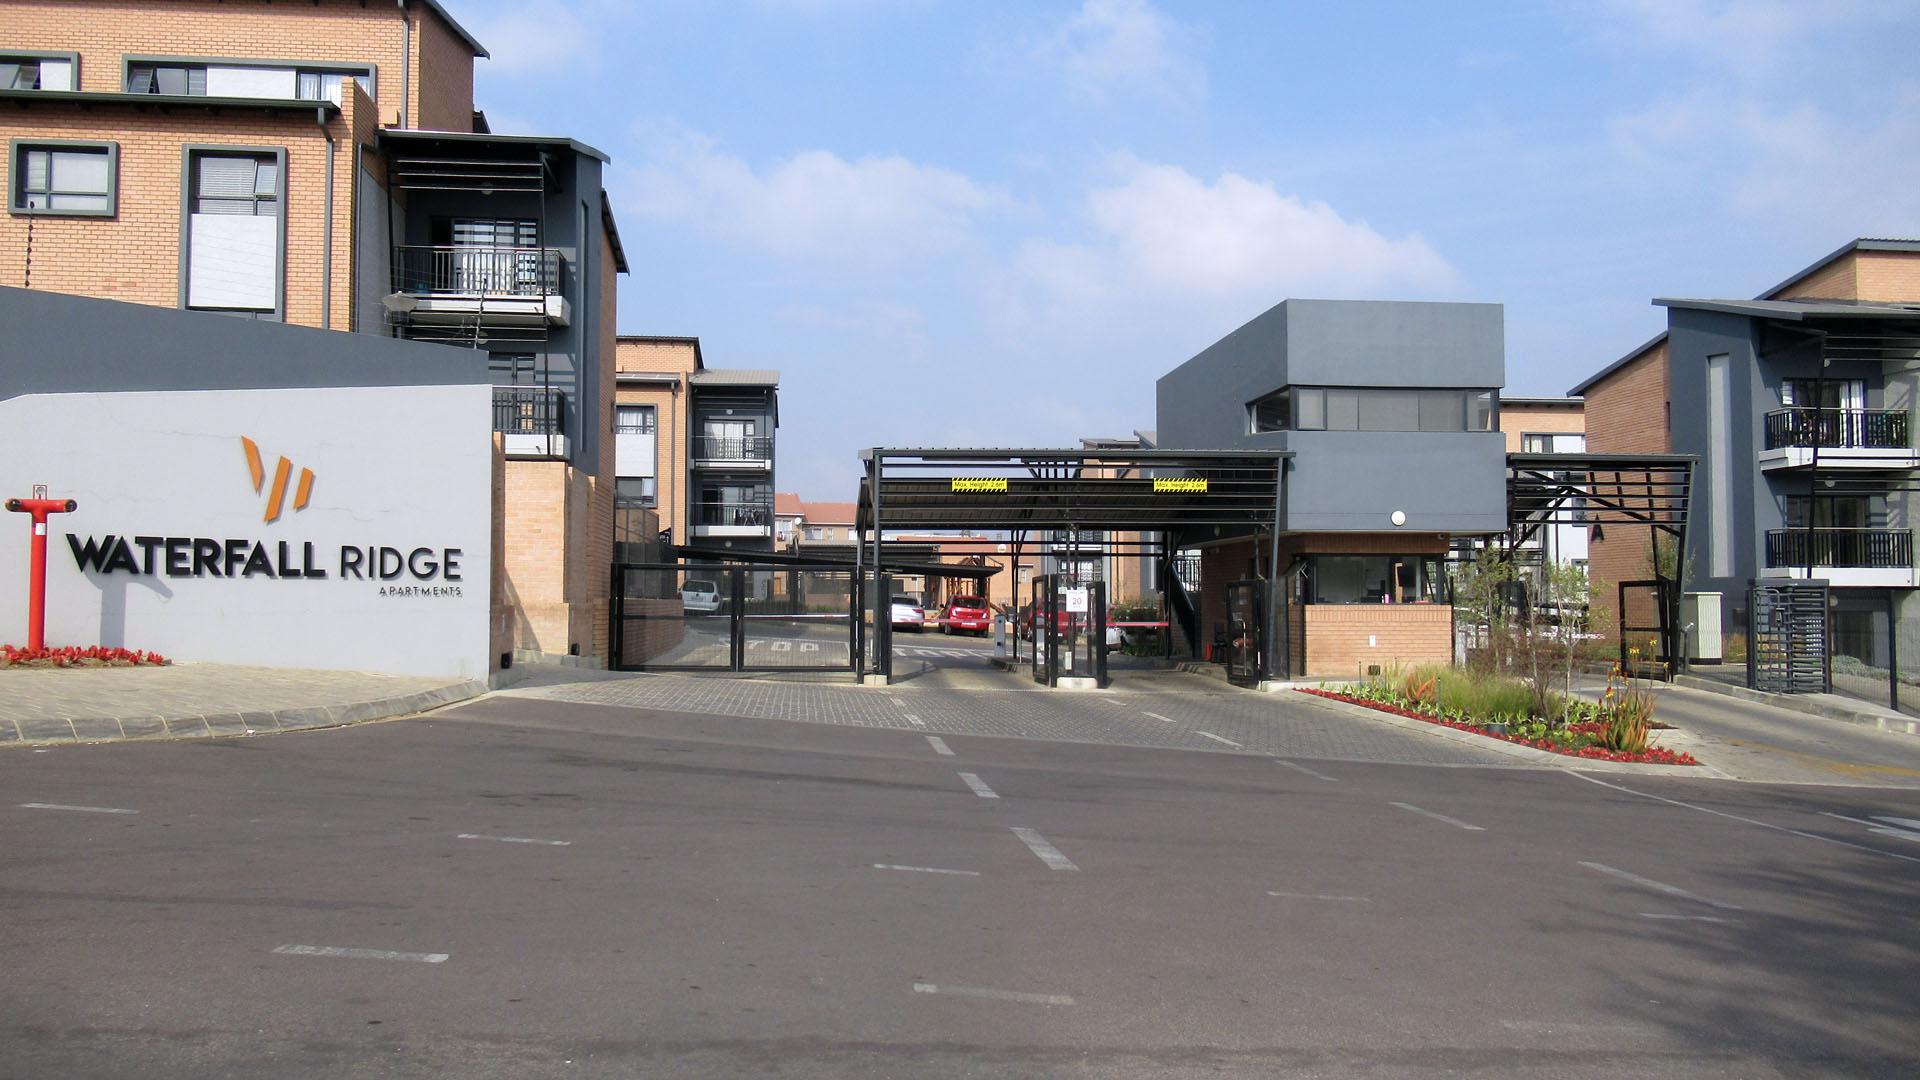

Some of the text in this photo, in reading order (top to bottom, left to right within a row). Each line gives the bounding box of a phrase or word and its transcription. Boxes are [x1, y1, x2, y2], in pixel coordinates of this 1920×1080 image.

[66, 533, 462, 580] WATERFALL RIDGE
[379, 586, 462, 596] APARTMENTS
[1072, 597, 1082, 606] 20
